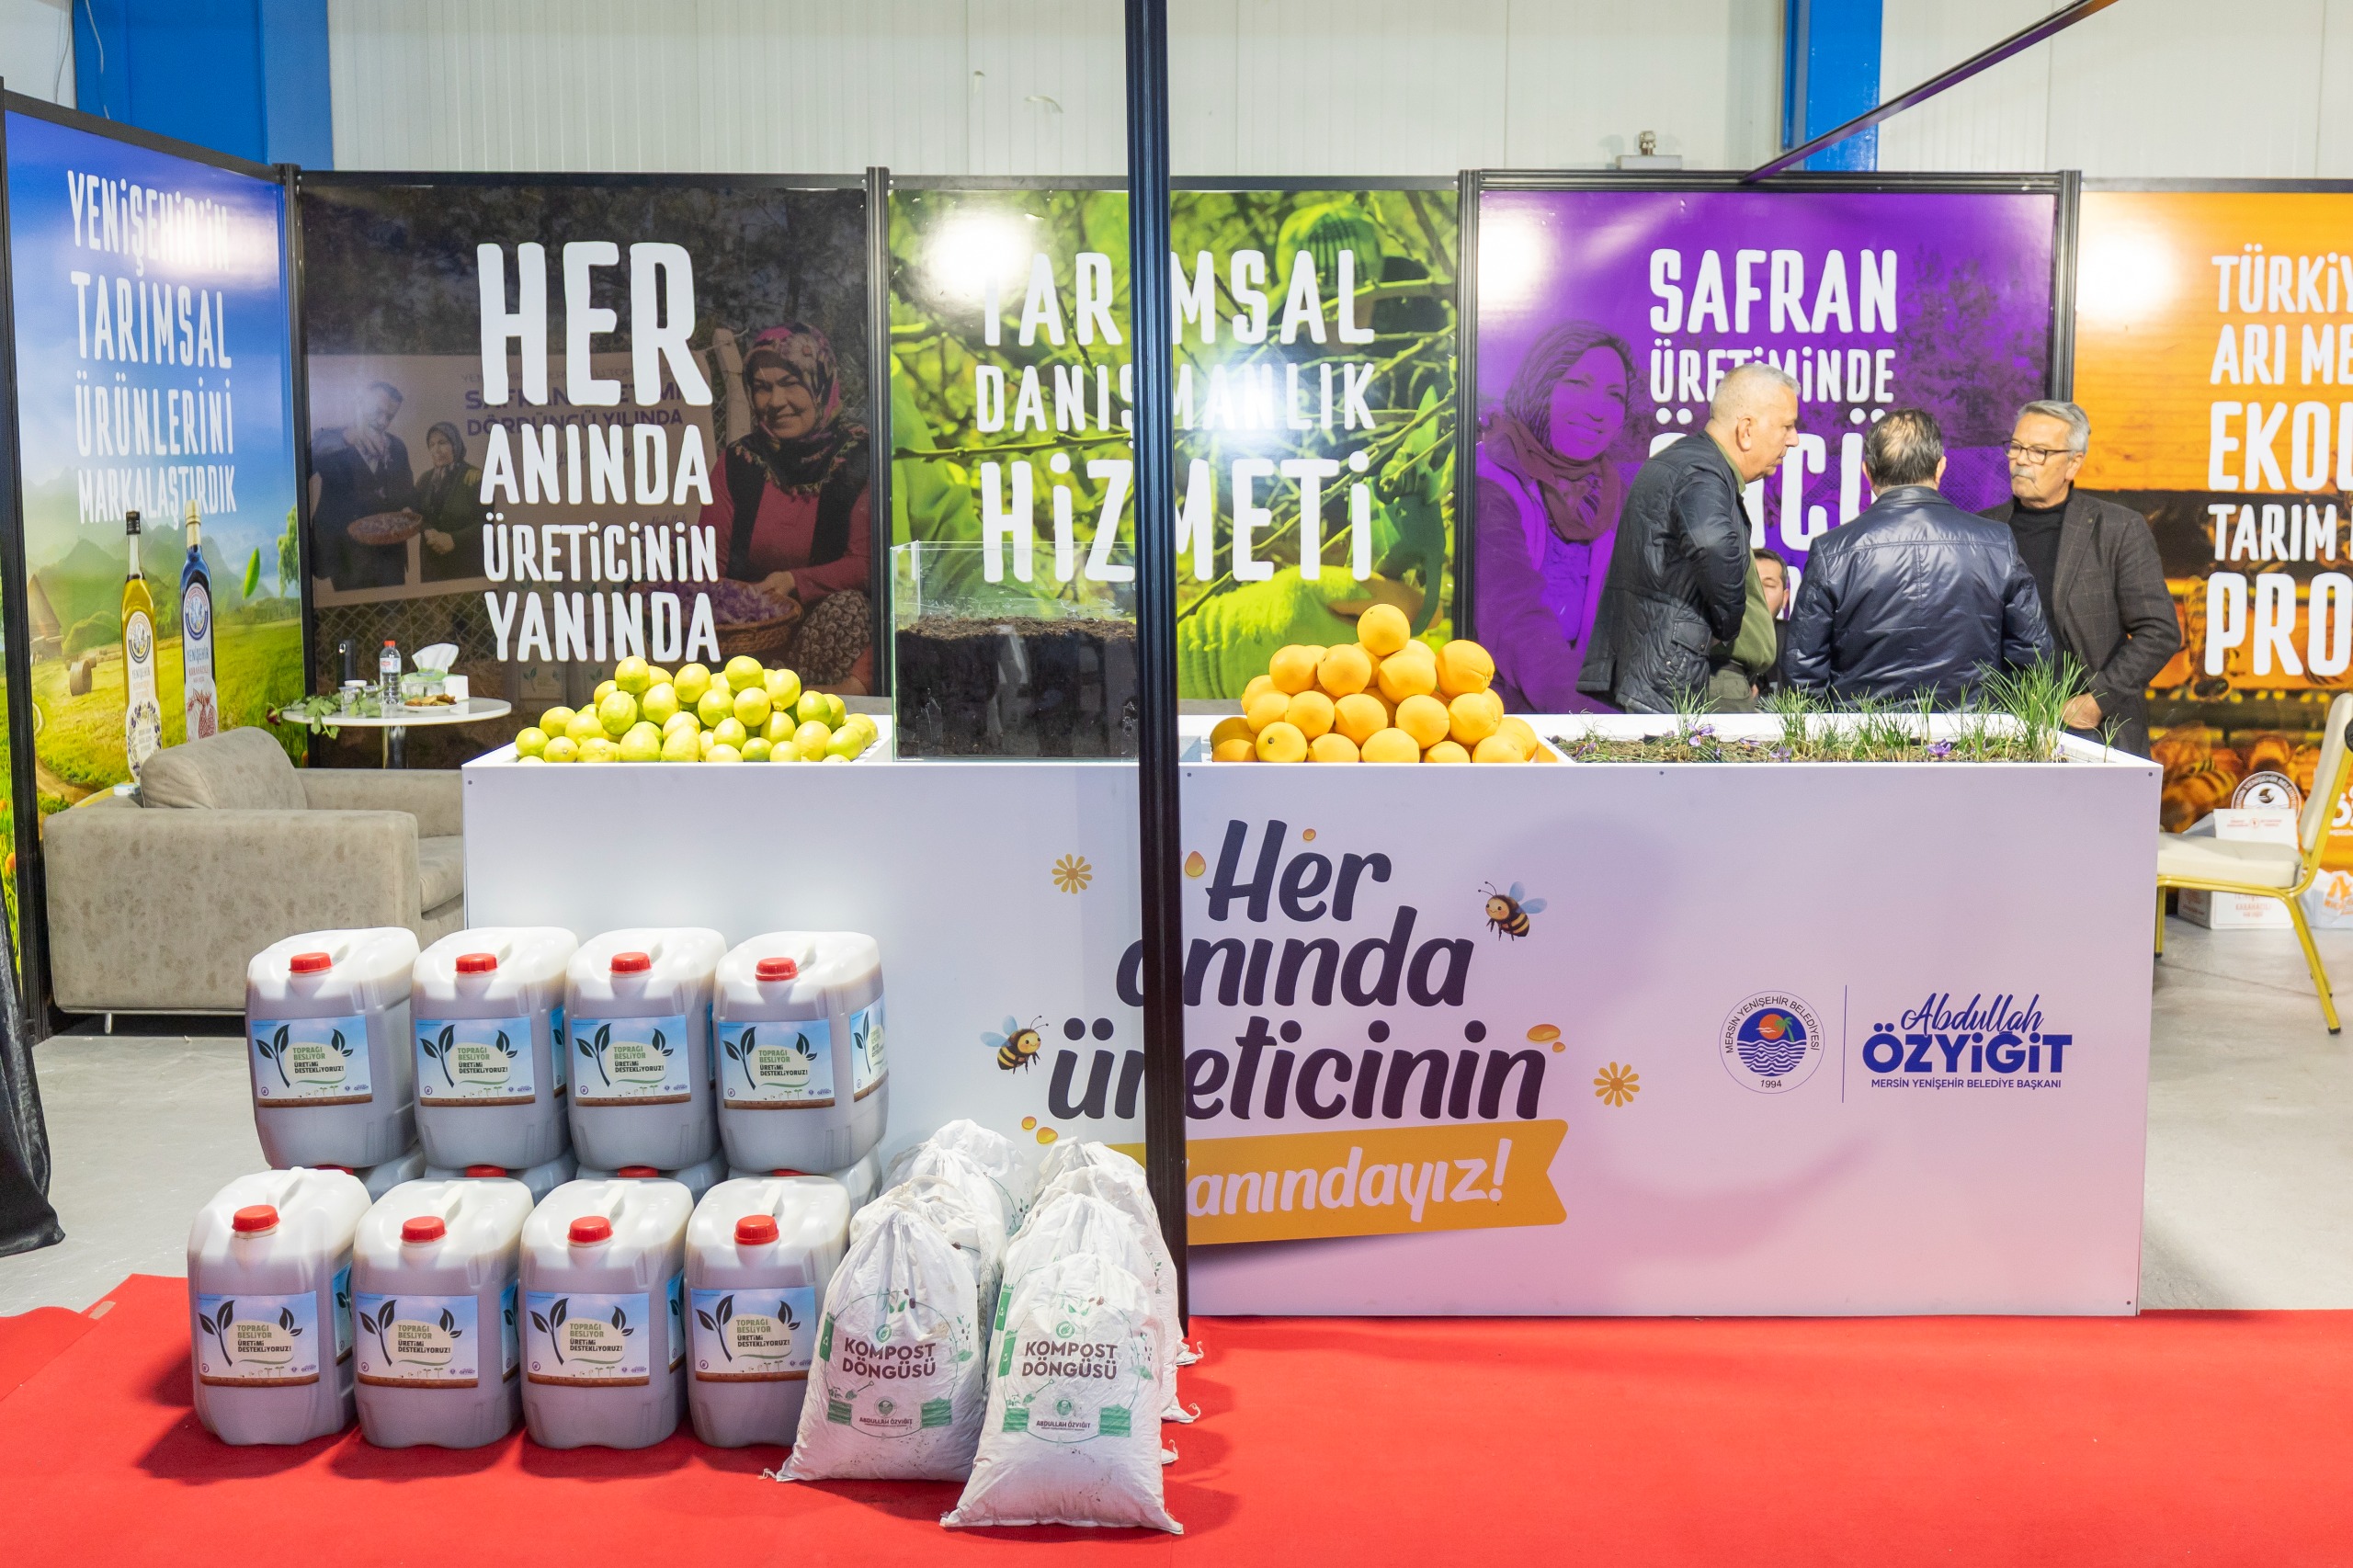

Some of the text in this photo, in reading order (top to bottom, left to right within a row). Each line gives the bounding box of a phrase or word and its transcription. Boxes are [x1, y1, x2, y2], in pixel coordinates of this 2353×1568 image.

[71, 271, 232, 369] TARIMSAL
[1650, 248, 1897, 334] SAFRAN
[477, 242, 713, 406] HER
[2210, 324, 2286, 384] ARI
[480, 424, 713, 505] ANINDA
[78, 465, 236, 530] MARKALAŞTIRDIK
[2208, 504, 2336, 562] TARIM
[484, 592, 721, 662] YANINDA
[2204, 572, 2353, 676] PRO
[1205, 819, 1392, 922] Her
[1901, 993, 2044, 1037] Abdullah
[1761, 1079, 1782, 1088] 1994
[1871, 1077, 1909, 1088] MERSİN
[2018, 1079, 2062, 1090] BAŞKANI
[1186, 1138, 1513, 1223] anındayız!
[842, 1356, 936, 1380] DÖNGÜSÜ
[844, 1337, 937, 1360] KOMPOST
[1022, 1357, 1117, 1380] DÖNGÜSÜ
[1024, 1341, 1119, 1359] KOMPOST
